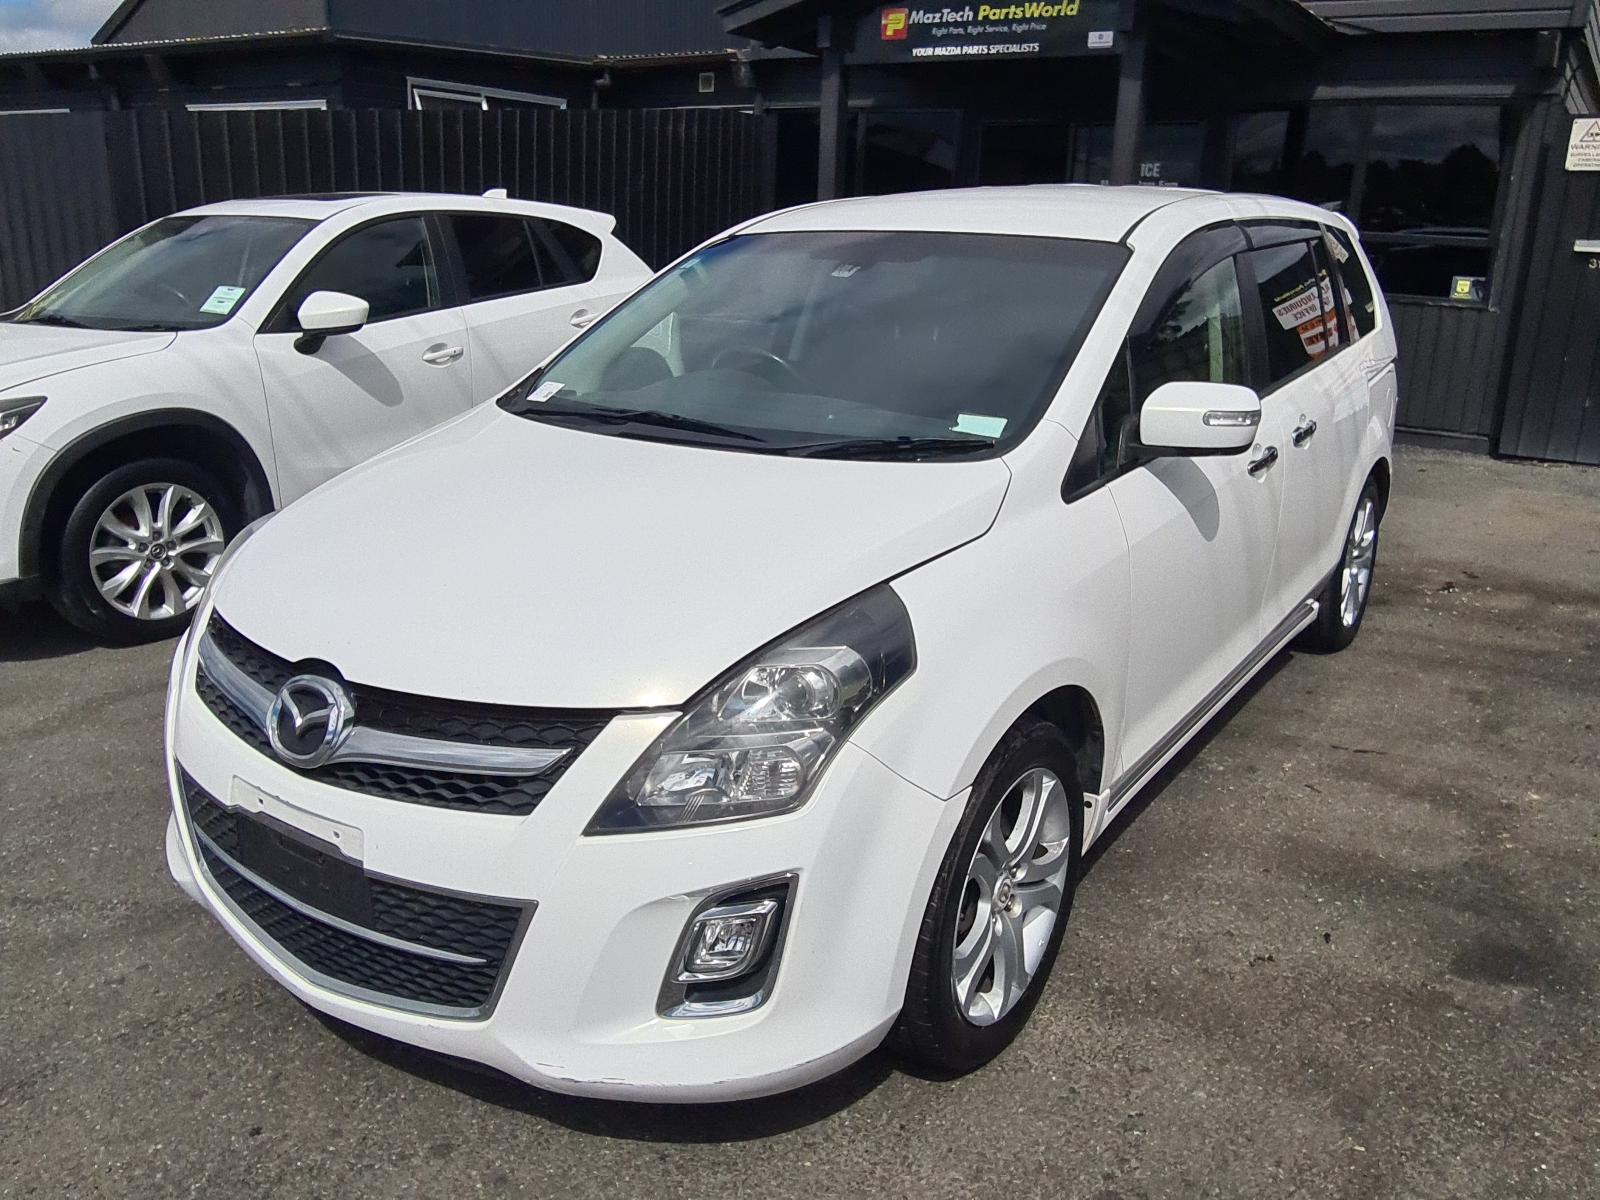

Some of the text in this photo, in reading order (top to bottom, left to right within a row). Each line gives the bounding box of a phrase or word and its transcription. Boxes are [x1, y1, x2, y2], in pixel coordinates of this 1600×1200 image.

[909, 0, 1081, 25] MazTech PartsWorld
[1030, 22, 1047, 31] Price
[912, 43, 1040, 57] YOUR MAZDA PARTS SPECIALISTS
